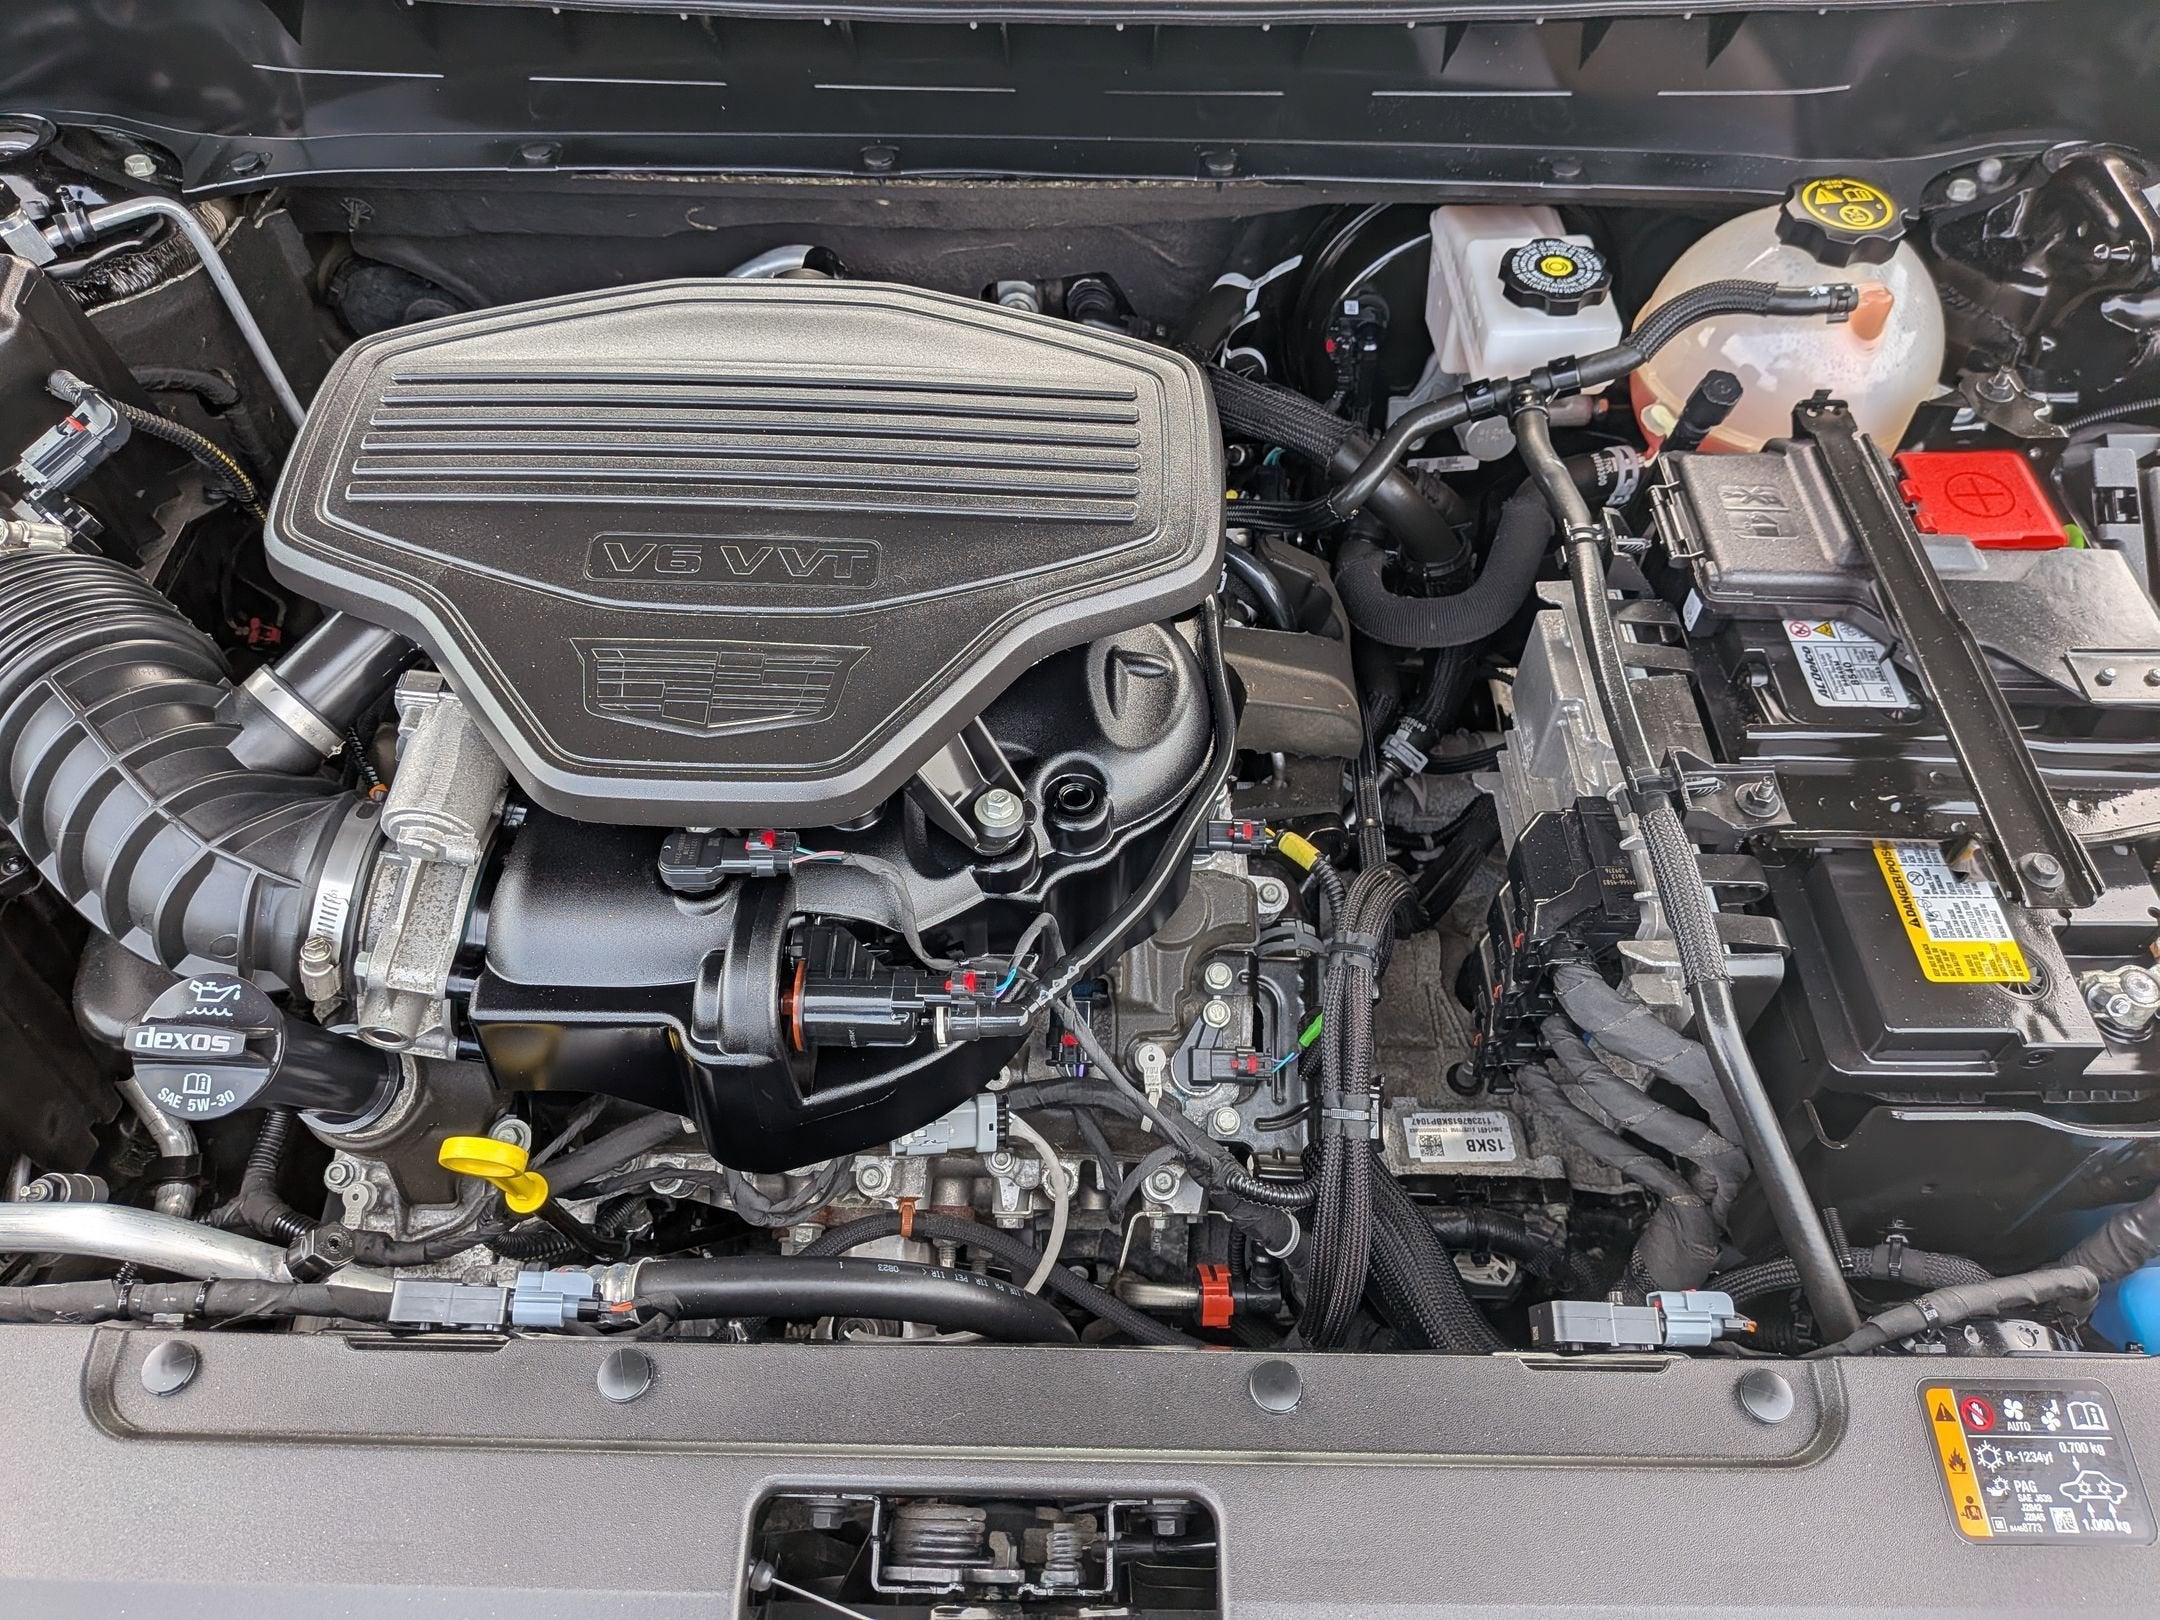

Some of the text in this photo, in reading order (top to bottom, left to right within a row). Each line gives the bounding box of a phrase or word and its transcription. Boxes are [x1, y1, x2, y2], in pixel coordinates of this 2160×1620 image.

[603, 542, 869, 578] V6 VVT
[1801, 645, 1830, 699] ACDelco
[1842, 661, 1860, 686] 8540
[1881, 848, 1917, 917] DANGER/POIS
[135, 1026, 231, 1052] dexos
[158, 1087, 235, 1112] SAE 5W-30
[1466, 1139, 1506, 1152] 1SKB
[877, 1263, 899, 1273] 0823
[955, 1273, 968, 1283] PET
[2007, 1420, 2031, 1431] AUTO
[2058, 1441, 2106, 1456] 0.700 kg
[2005, 1451, 2054, 1465] R-1234yf
[2013, 1479, 2038, 1493] PAG
[2017, 1494, 2034, 1502] SAE
[2082, 1518, 2132, 1534] 1.000 kg
